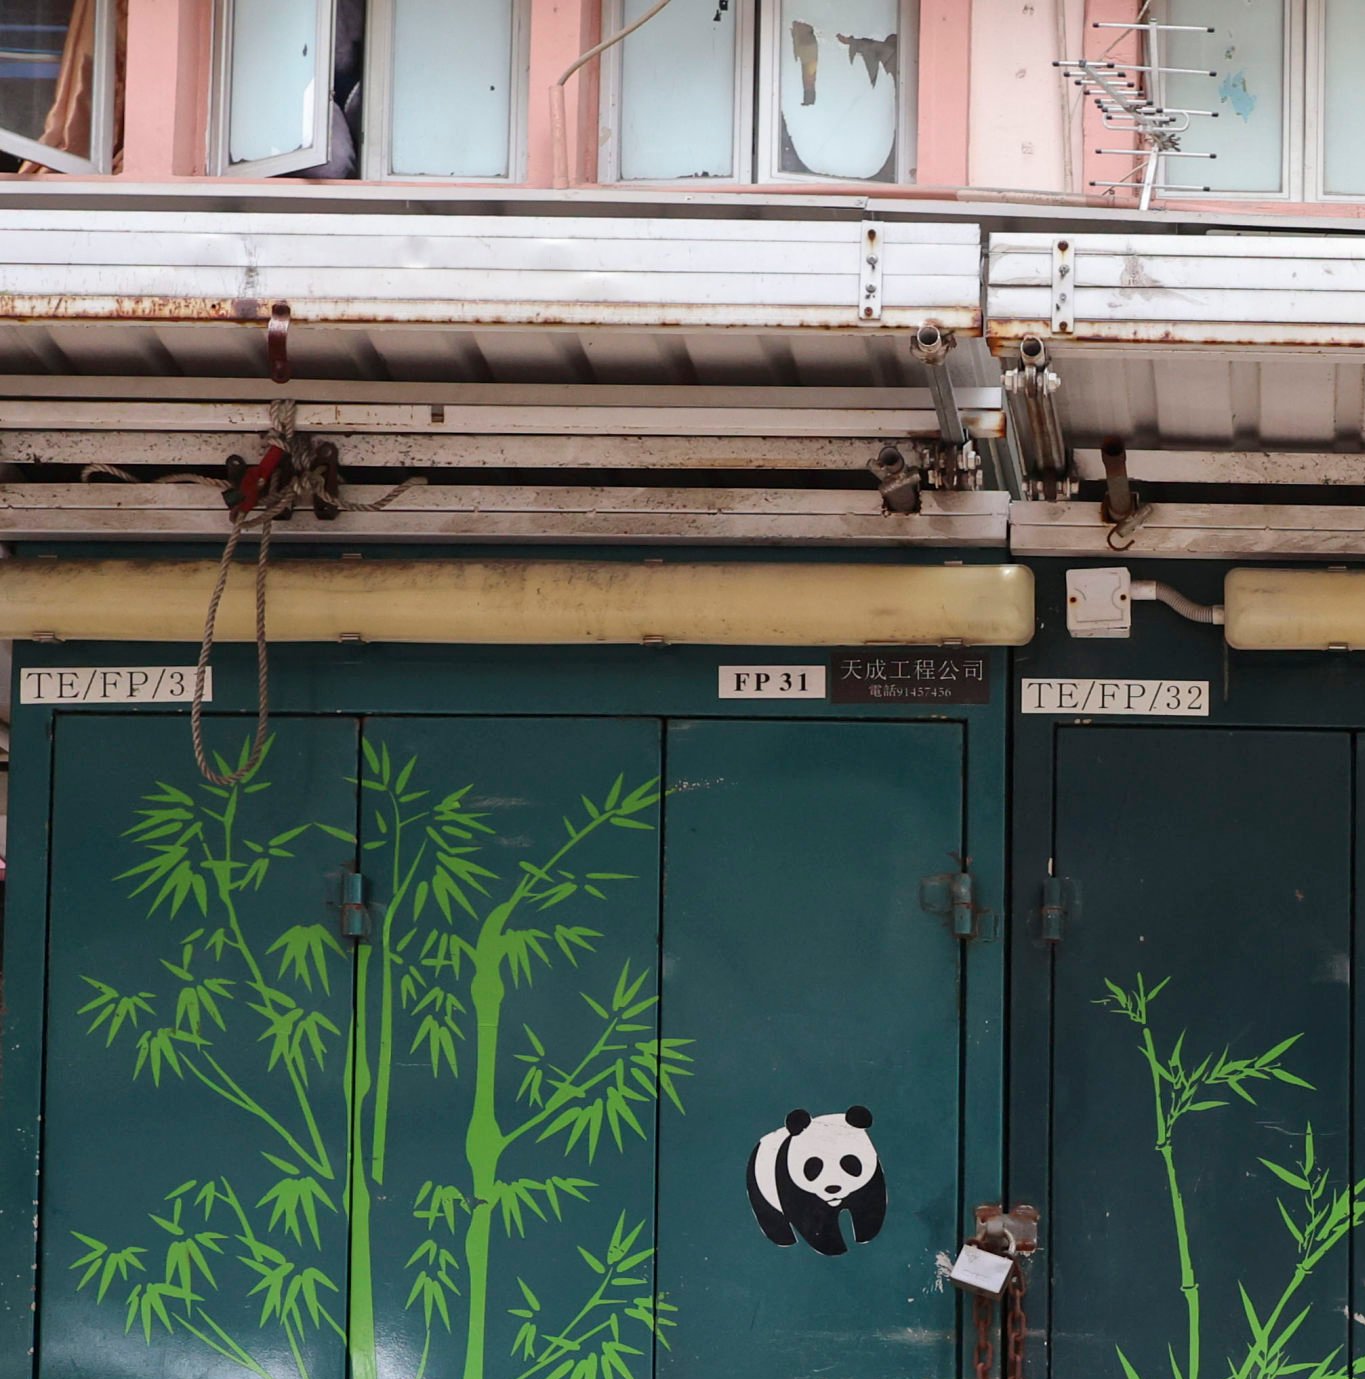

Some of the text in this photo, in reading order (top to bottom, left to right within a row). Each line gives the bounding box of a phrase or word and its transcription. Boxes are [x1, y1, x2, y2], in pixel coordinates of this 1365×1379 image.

[26, 668, 206, 700] TE/FP/3
[734, 672, 809, 691] FP 31
[840, 658, 984, 682] 天成工程公司
[1027, 680, 1203, 712] TE/FP/32
